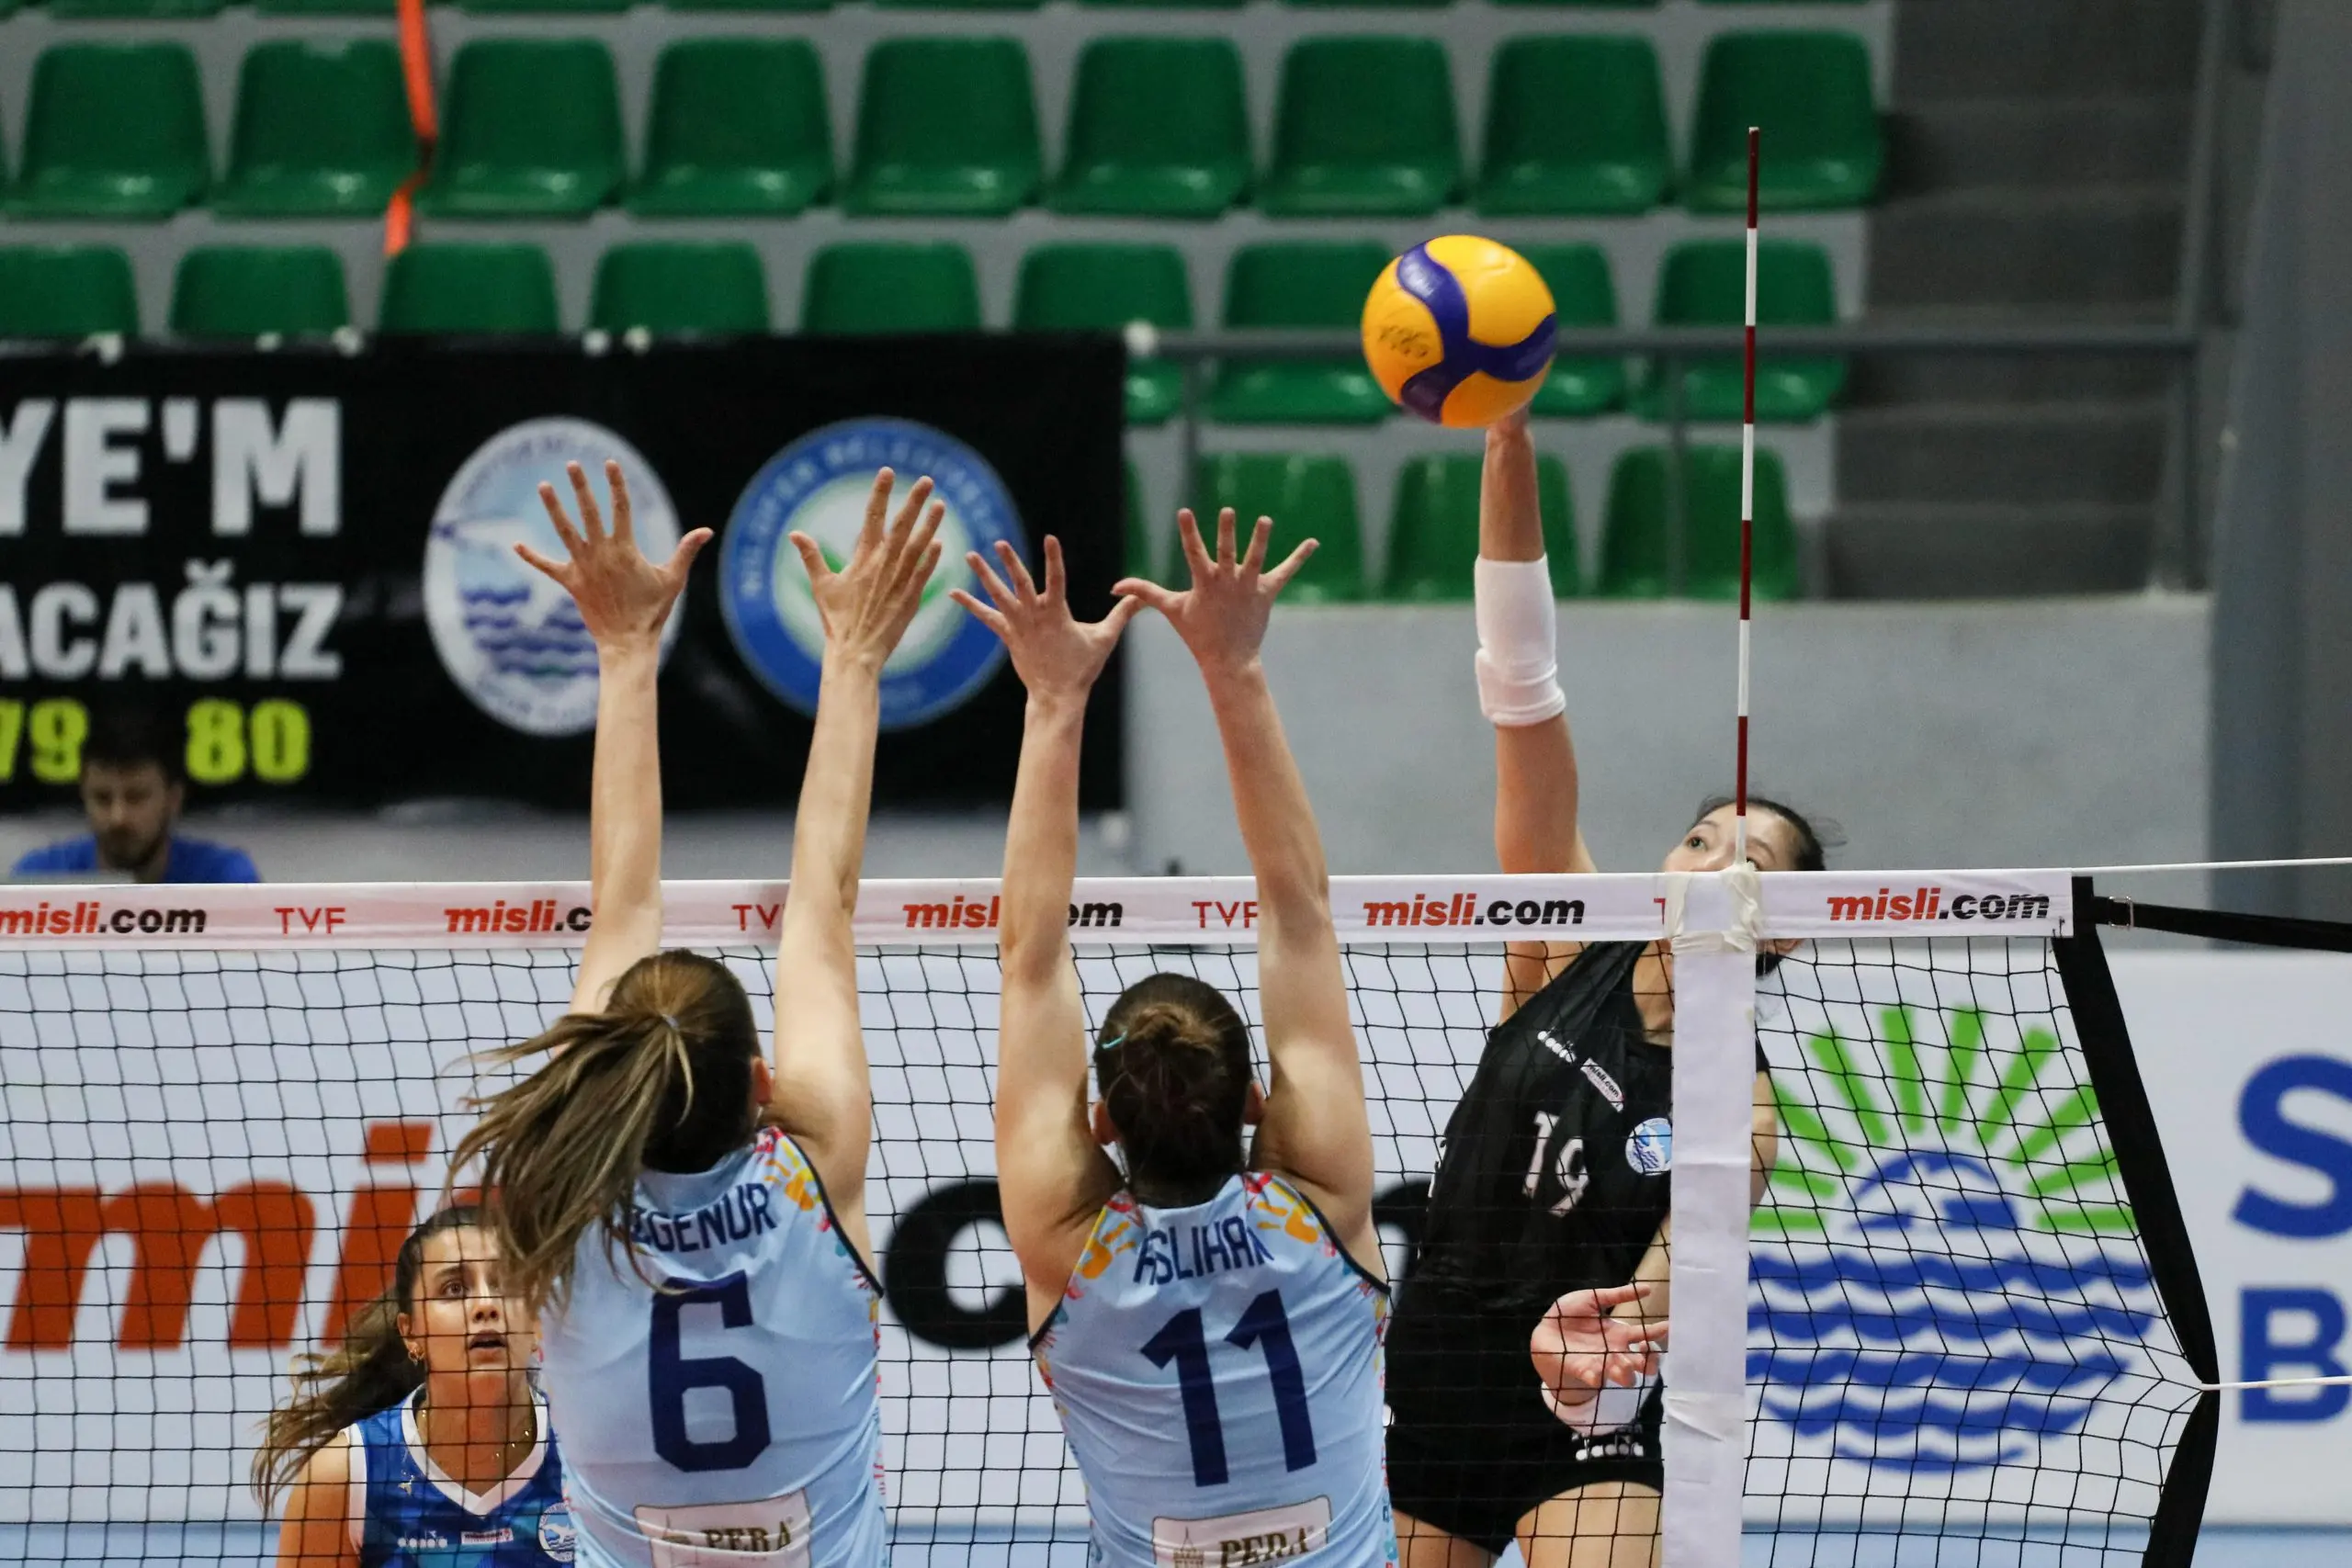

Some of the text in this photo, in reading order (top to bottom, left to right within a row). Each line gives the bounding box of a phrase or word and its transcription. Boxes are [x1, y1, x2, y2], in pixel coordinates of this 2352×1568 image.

[187, 700, 310, 783] 80
[0, 901, 207, 934] misli.com
[274, 907, 345, 935] TVF
[444, 899, 592, 933] misli.c
[732, 904, 785, 930] TV
[1363, 893, 1585, 927] misli.com
[1827, 887, 2050, 922] misli.com
[1521, 1110, 1590, 1217] 19
[649, 1269, 772, 1473] 6
[1140, 1288, 1317, 1487] 11
